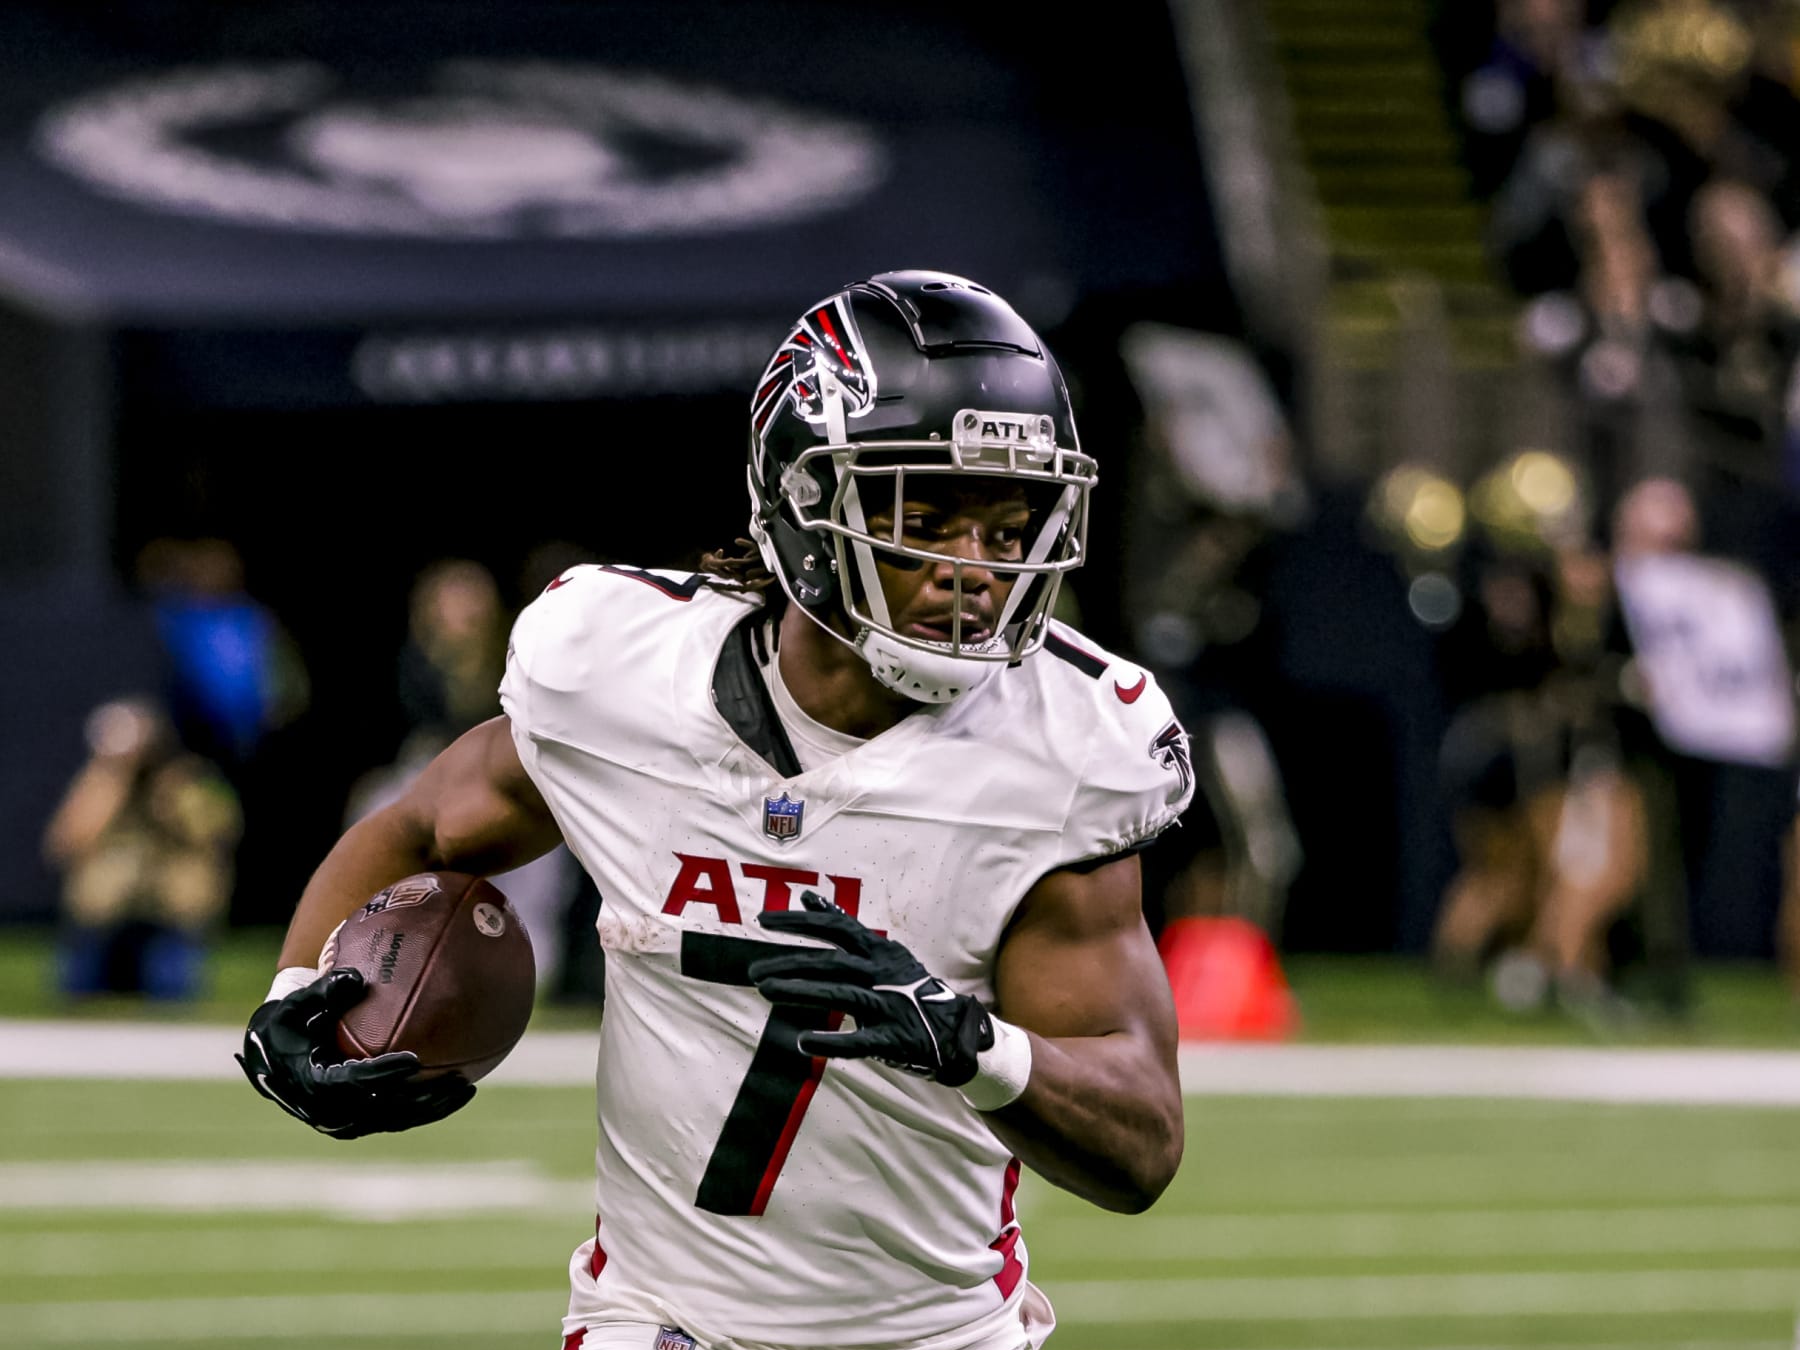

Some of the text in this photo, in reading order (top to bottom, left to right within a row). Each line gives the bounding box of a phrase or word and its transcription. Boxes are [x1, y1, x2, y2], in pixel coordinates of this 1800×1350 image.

[981, 421, 1028, 440] ATL
[769, 815, 797, 835] NFL
[660, 850, 888, 938] ATL
[680, 930, 848, 1218] 7
